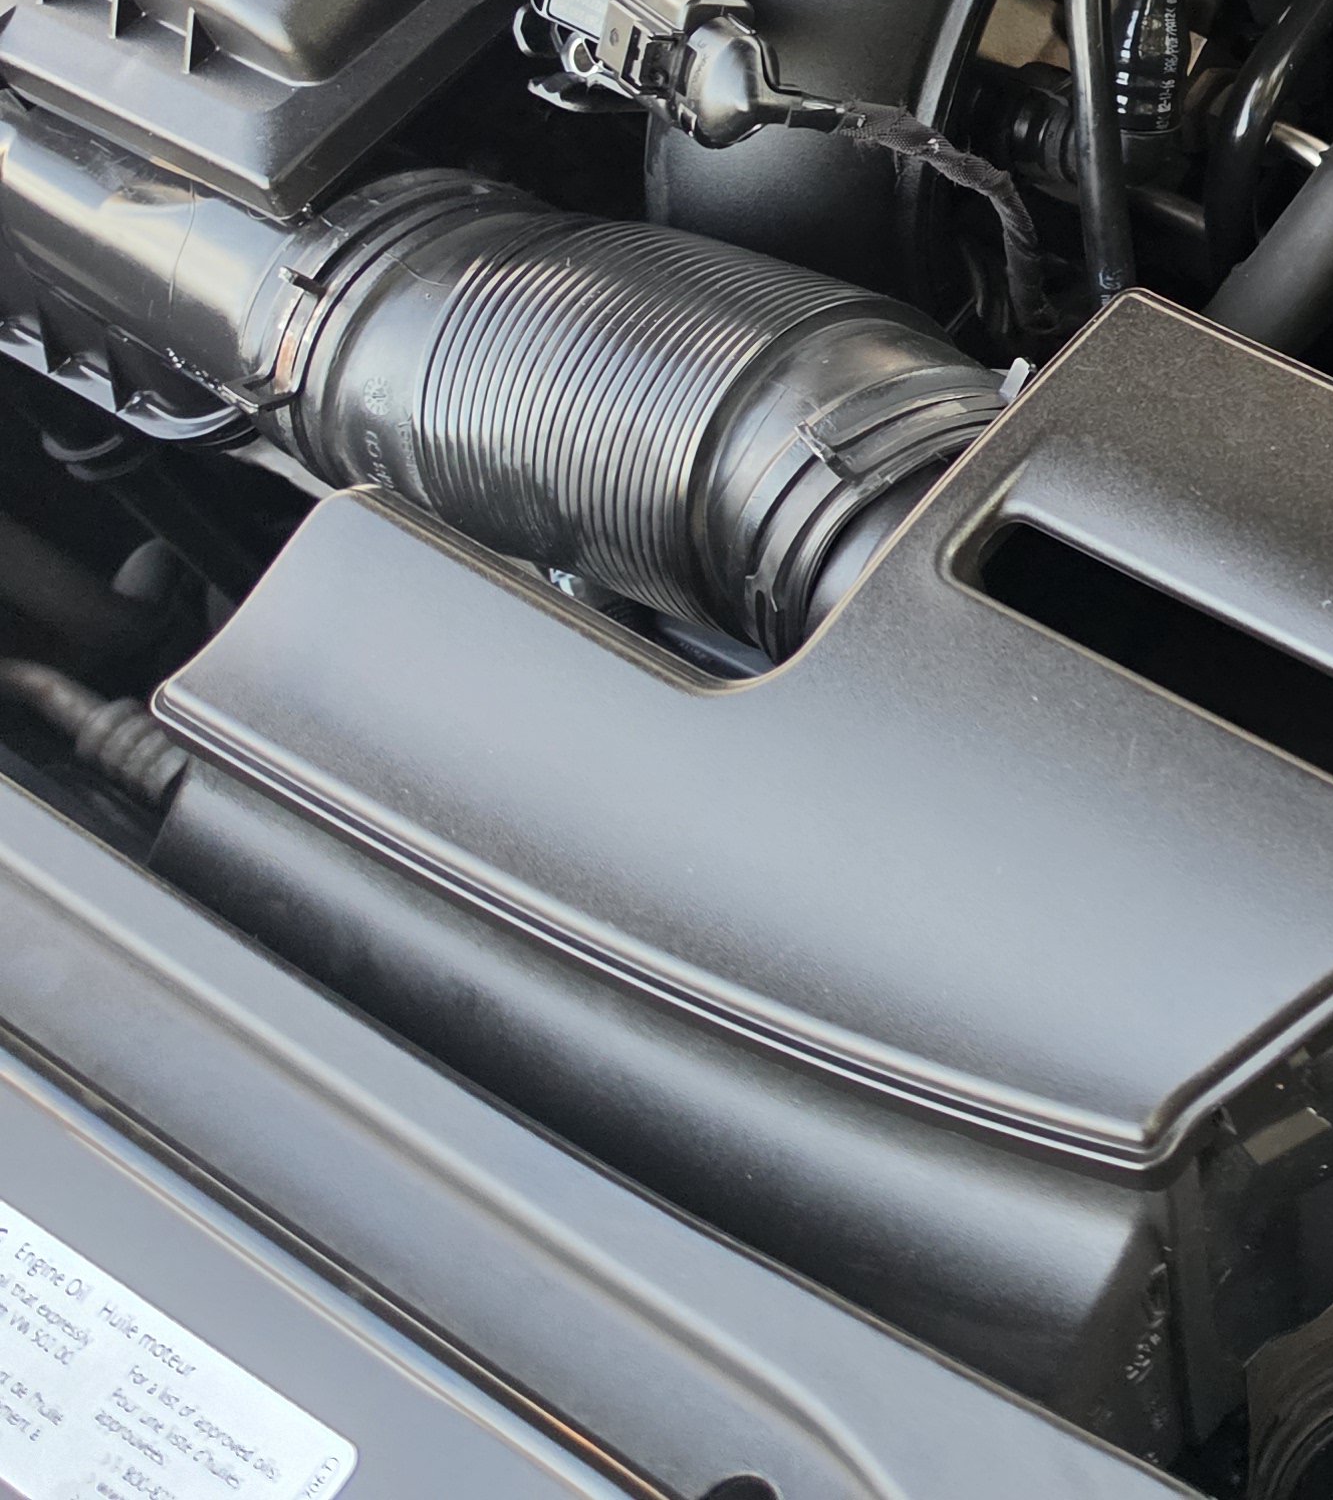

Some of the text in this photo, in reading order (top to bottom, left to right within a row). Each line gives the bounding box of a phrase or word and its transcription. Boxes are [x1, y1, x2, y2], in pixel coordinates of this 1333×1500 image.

[14, 1242, 94, 1301] Engine Oil
[99, 1300, 197, 1377] Huile moteur
